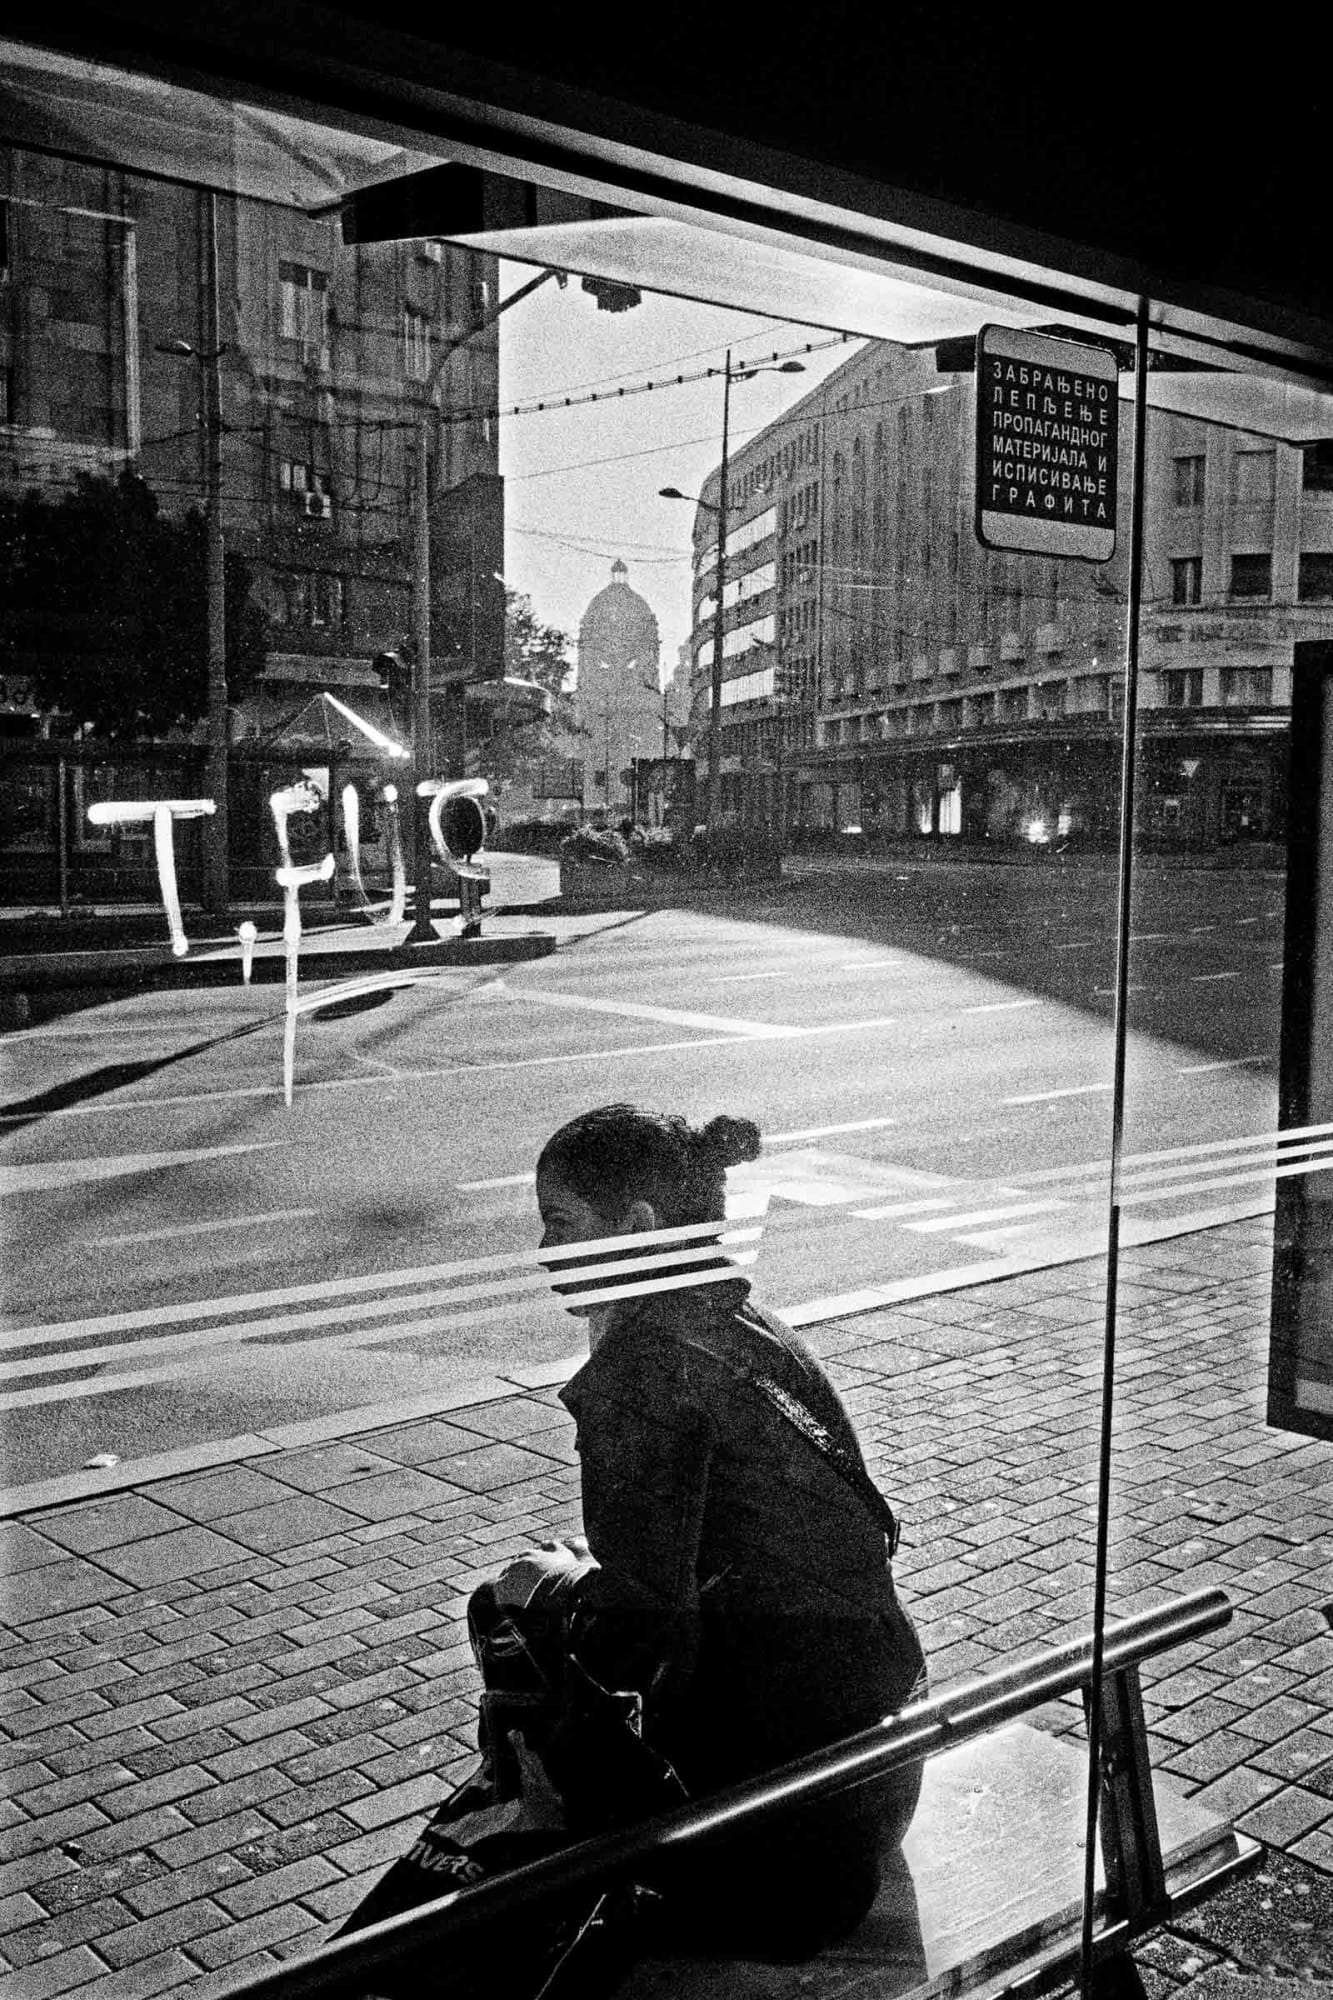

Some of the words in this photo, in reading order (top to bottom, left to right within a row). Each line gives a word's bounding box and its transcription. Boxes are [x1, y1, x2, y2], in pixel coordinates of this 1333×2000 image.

[993, 361, 1109, 402] ЗАБРАЊЕНО
[993, 386, 1109, 426] ЛЕПЉЕЊЕ
[993, 411, 1109, 448] ПРОПАГАНДНОГ
[993, 435, 1088, 468] МАТЕРИЈАЛА
[1098, 456, 1107, 473] И
[993, 460, 1107, 496] ИСПИСИВАЊЕ
[992, 484, 1107, 519] ГРАФИТА
